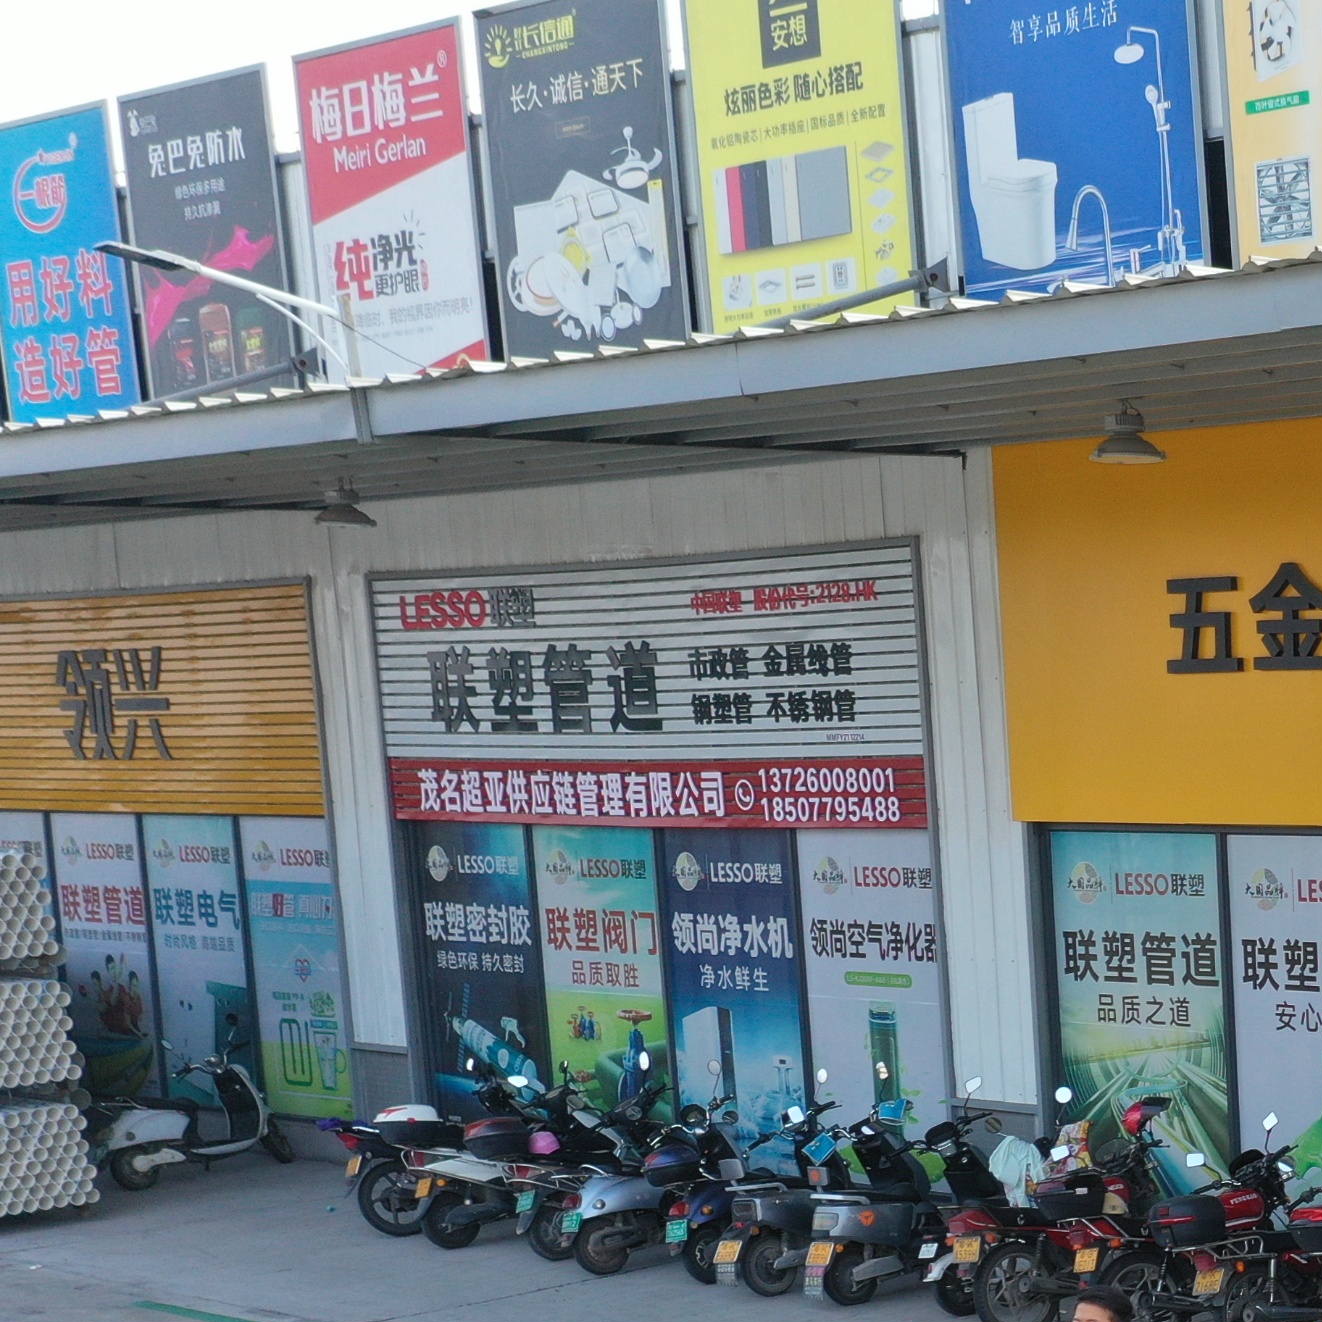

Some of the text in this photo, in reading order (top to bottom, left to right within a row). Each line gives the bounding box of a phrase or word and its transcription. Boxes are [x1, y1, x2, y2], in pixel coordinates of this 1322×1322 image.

[522, 14, 575, 49] 长信通
[770, 14, 807, 51] 安想
[1009, 0, 1118, 46] 智享品质生活
[724, 61, 864, 117] 炫丽色彩 随心搭配
[810, 111, 846, 131] 国标品质
[851, 104, 886, 123] 全新配置
[333, 134, 427, 173] Meiri Gerlan
[6, 248, 114, 328] 用好料
[375, 268, 420, 297] 更护眼
[14, 325, 122, 404] 造好管
[399, 587, 536, 630] LESSO 联塑
[687, 642, 852, 681] 市政管 金属线管
[427, 640, 664, 734] 联塑管道
[690, 689, 856, 725] 钢塑管 不锈钢管
[417, 770, 725, 818] 茂名超亚供应链管理有限公司
[757, 767, 896, 796] 13726008001
[760, 797, 901, 823] 18507795488
[86, 843, 115, 861] LESSO
[115, 844, 135, 861] 联塑
[179, 845, 211, 863] LESSO
[211, 846, 231, 865] 联塑
[281, 848, 314, 867] LESSO
[457, 855, 520, 876] LESSO 联塑
[580, 859, 646, 880] LESSO 联塑
[710, 862, 783, 884] LESSO 联塑
[854, 866, 932, 889] LESSO 联塑
[1114, 872, 1206, 898] LESSO 联塑
[60, 884, 146, 926] 联塑管道
[152, 888, 240, 930] 联塑电气
[424, 901, 532, 946] 联塑密封胶
[545, 907, 658, 955] 联塑阀门
[671, 911, 794, 959] 领尚净水机
[809, 917, 938, 965] 领尚空气净化器
[437, 950, 525, 974] 绿色环保 持久密封
[572, 960, 640, 988] 品质取胜
[1062, 929, 1220, 988] 联塑管道
[700, 964, 769, 992] 净水鲜生
[1097, 993, 1192, 1027] 品质之道
